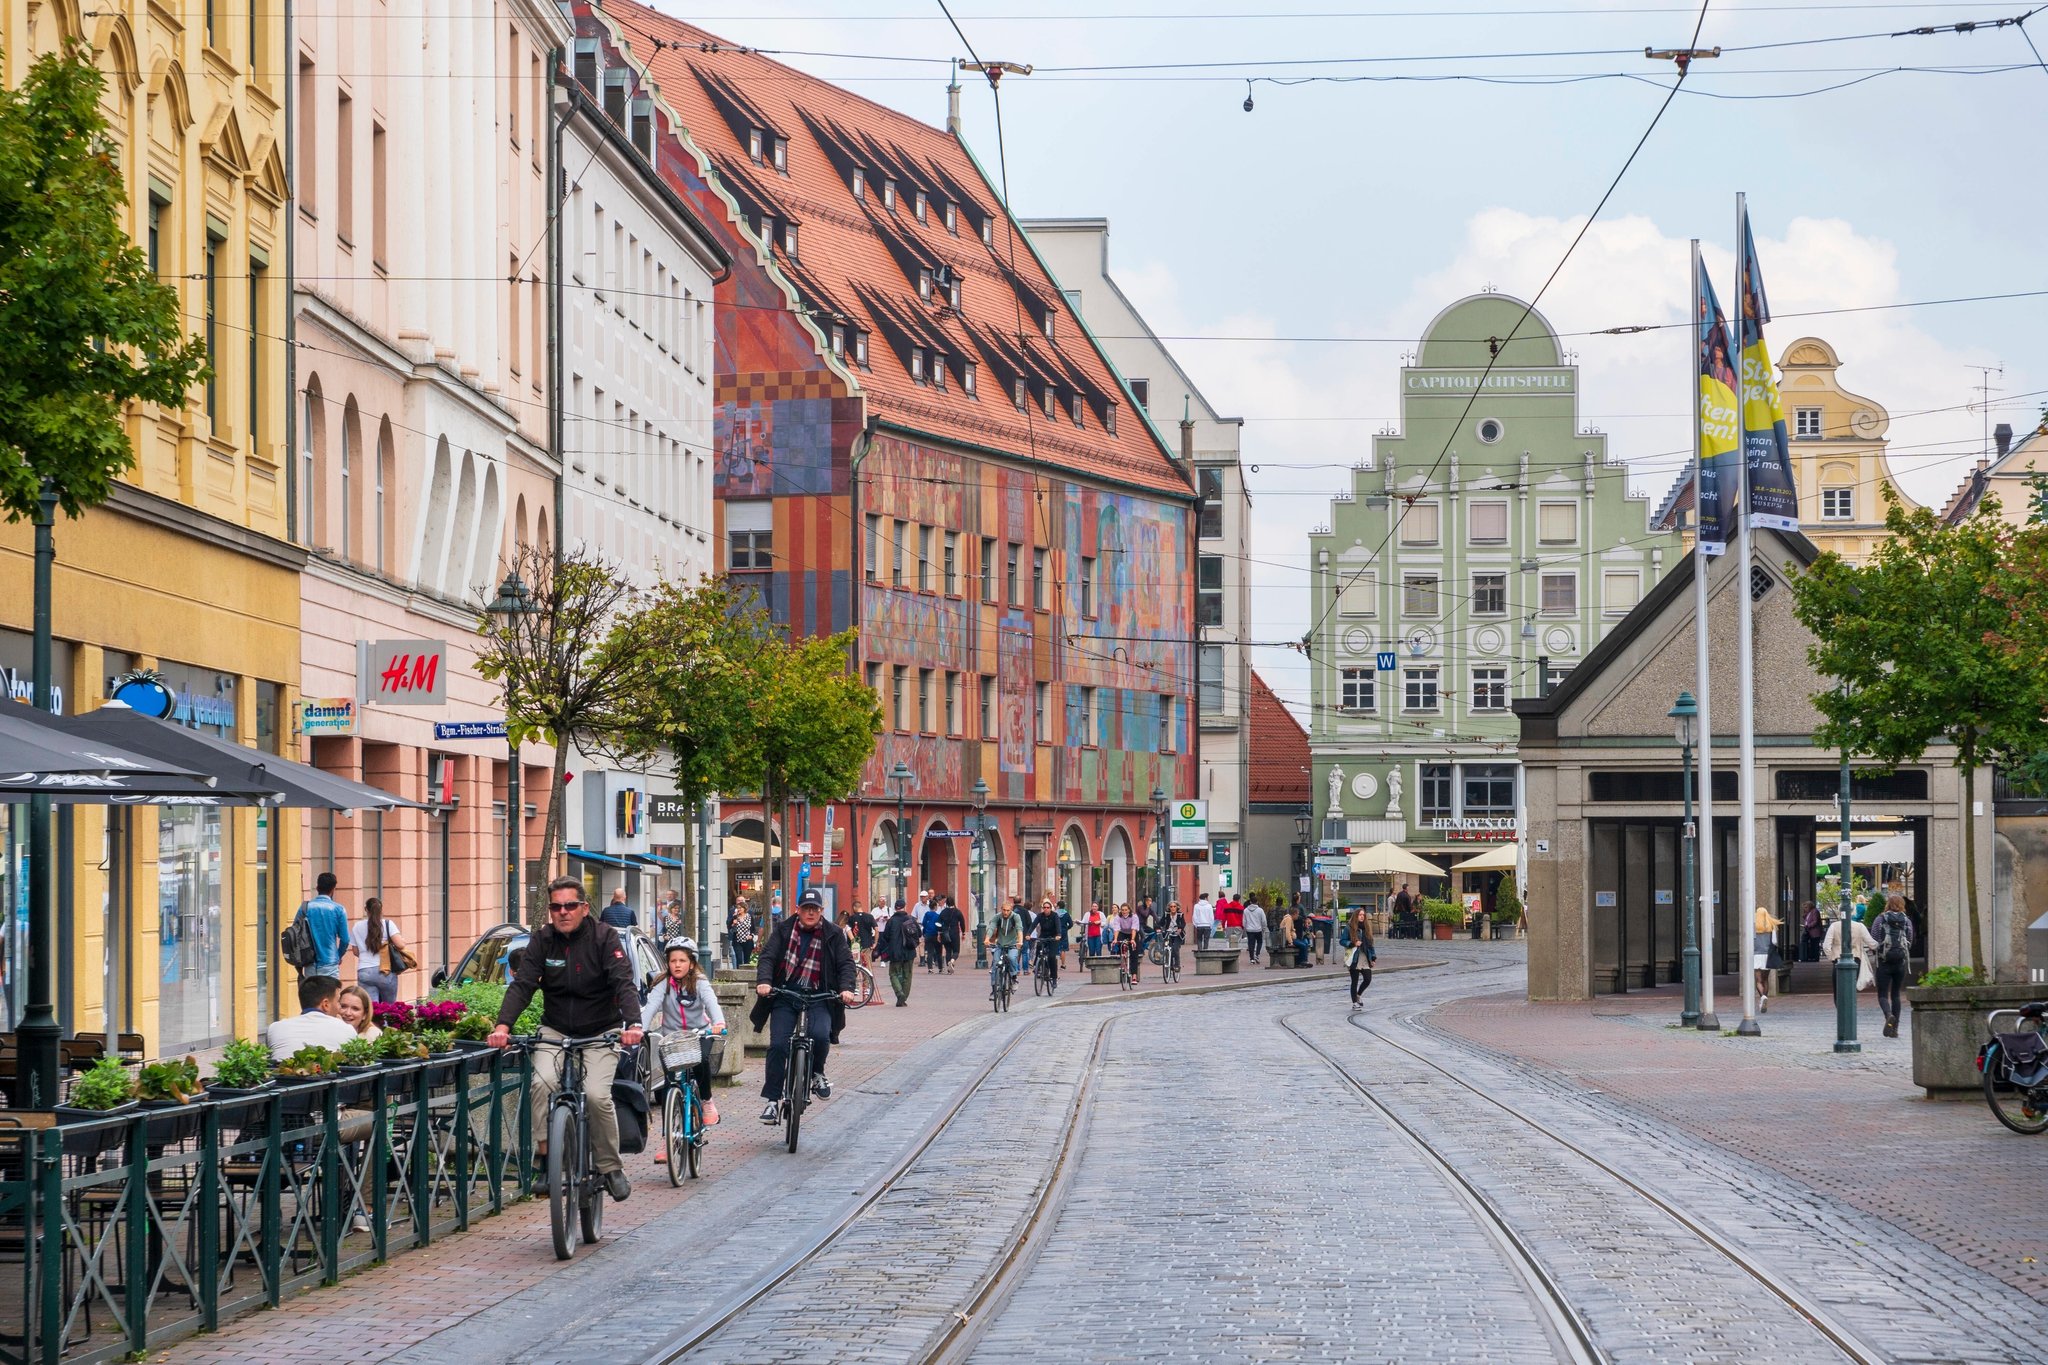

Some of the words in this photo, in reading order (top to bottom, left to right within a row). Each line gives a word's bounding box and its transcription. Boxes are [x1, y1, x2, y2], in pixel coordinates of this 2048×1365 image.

[1750, 437, 1773, 446] man
[1379, 654, 1394, 668] W
[381, 654, 439, 693] H&M
[304, 703, 352, 719] dampf
[305, 718, 351, 730] generation
[1432, 818, 1493, 830] HENRY'S
